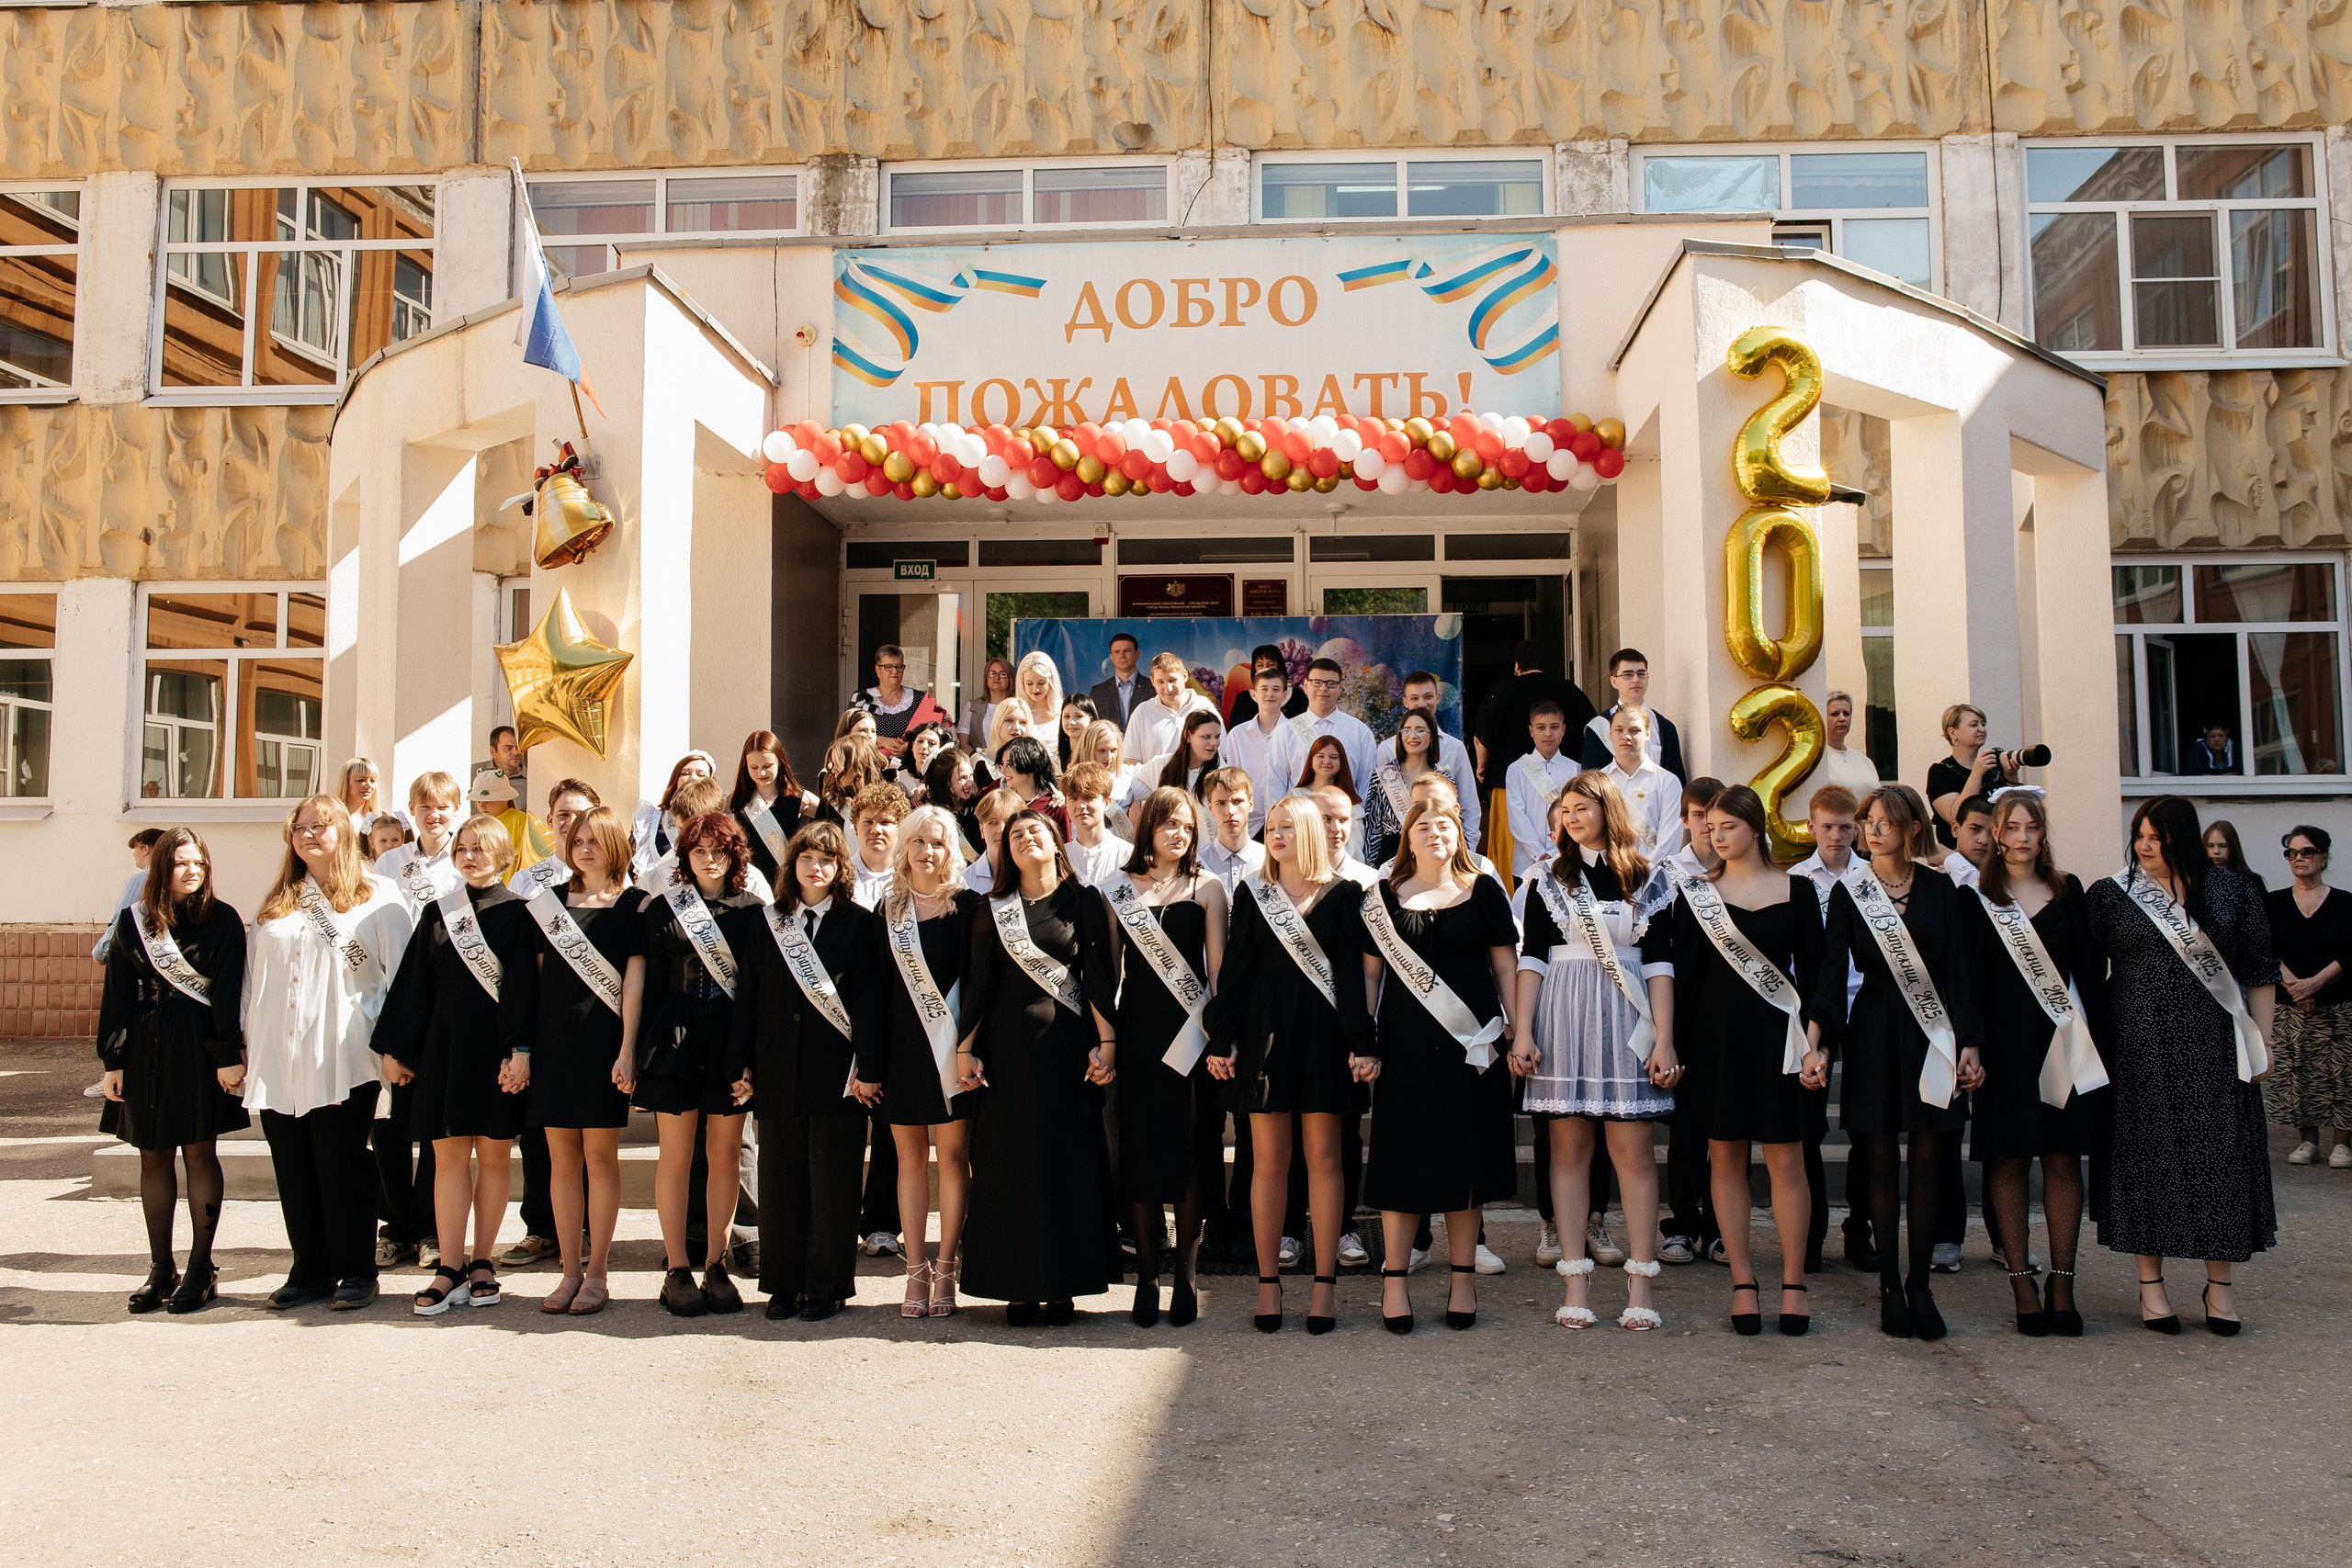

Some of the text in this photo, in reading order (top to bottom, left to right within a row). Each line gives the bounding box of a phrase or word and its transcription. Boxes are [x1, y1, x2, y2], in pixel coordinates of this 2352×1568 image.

[1065, 275, 1318, 344] ДОБРО
[913, 370, 1473, 429] ПОЖАЛОВАТЬ!
[900, 564, 930, 578] ВХОД
[1455, 603, 1487, 613] ВХОД
[298, 886, 368, 966] Выпускник 2025
[682, 911, 735, 988] Выпускник
[1003, 929, 1068, 998] Выпускник
[1119, 901, 1204, 1001] Выпускник 2025
[1265, 901, 1329, 980] Выпускница
[1362, 897, 1414, 974] Выпускница
[1690, 894, 1754, 974] Выпускник
[1753, 964, 1785, 993] 2025
[1864, 904, 1943, 1020] Выпускник 2025
[1987, 901, 2074, 1014] Выпускник 2025
[2131, 881, 2223, 977] Выпускник 2025
[921, 991, 947, 1019] 2025
